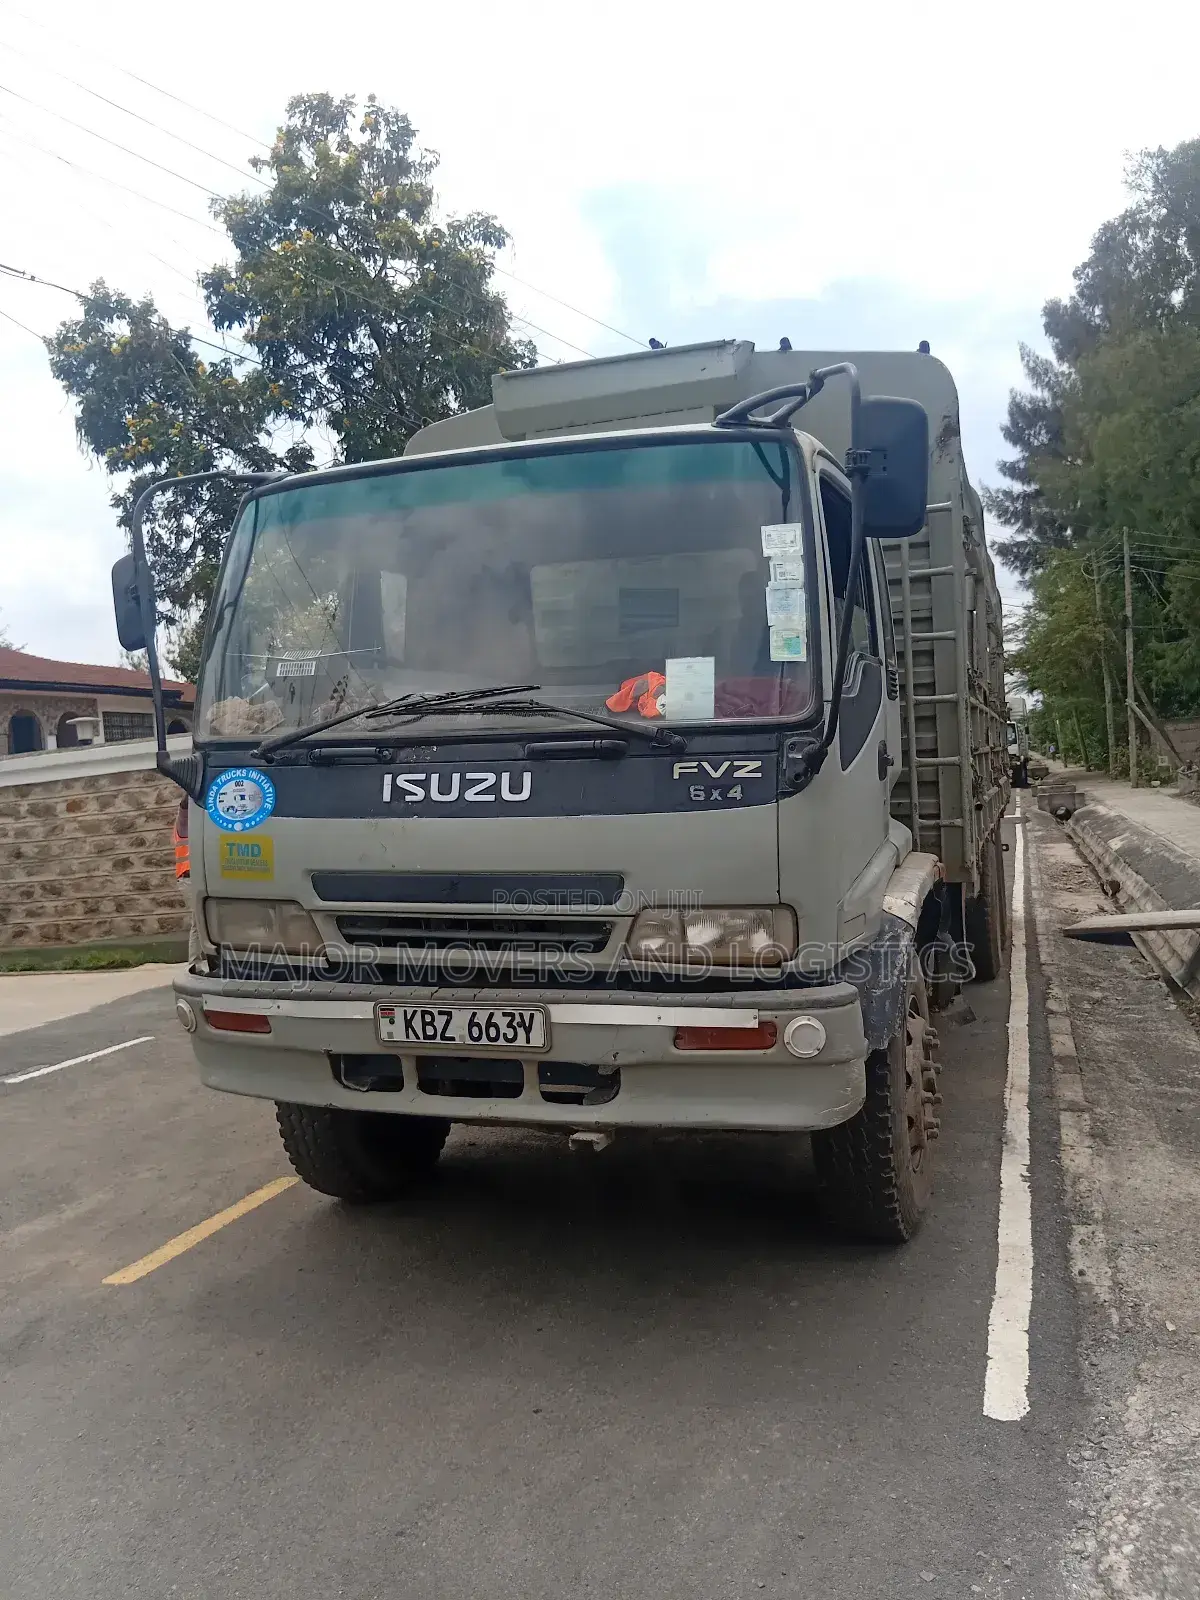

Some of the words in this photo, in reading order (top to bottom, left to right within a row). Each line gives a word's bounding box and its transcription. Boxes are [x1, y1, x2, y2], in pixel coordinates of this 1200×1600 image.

[673, 760, 763, 780] FVZ
[208, 785, 218, 813] LINDA
[217, 769, 247, 786] TRUCKS
[248, 770, 274, 810] INITIATIVE
[382, 771, 532, 802] ISUZU
[225, 842, 262, 858] TMD
[403, 1009, 456, 1042] KBZ
[467, 1011, 535, 1044] 663Y
